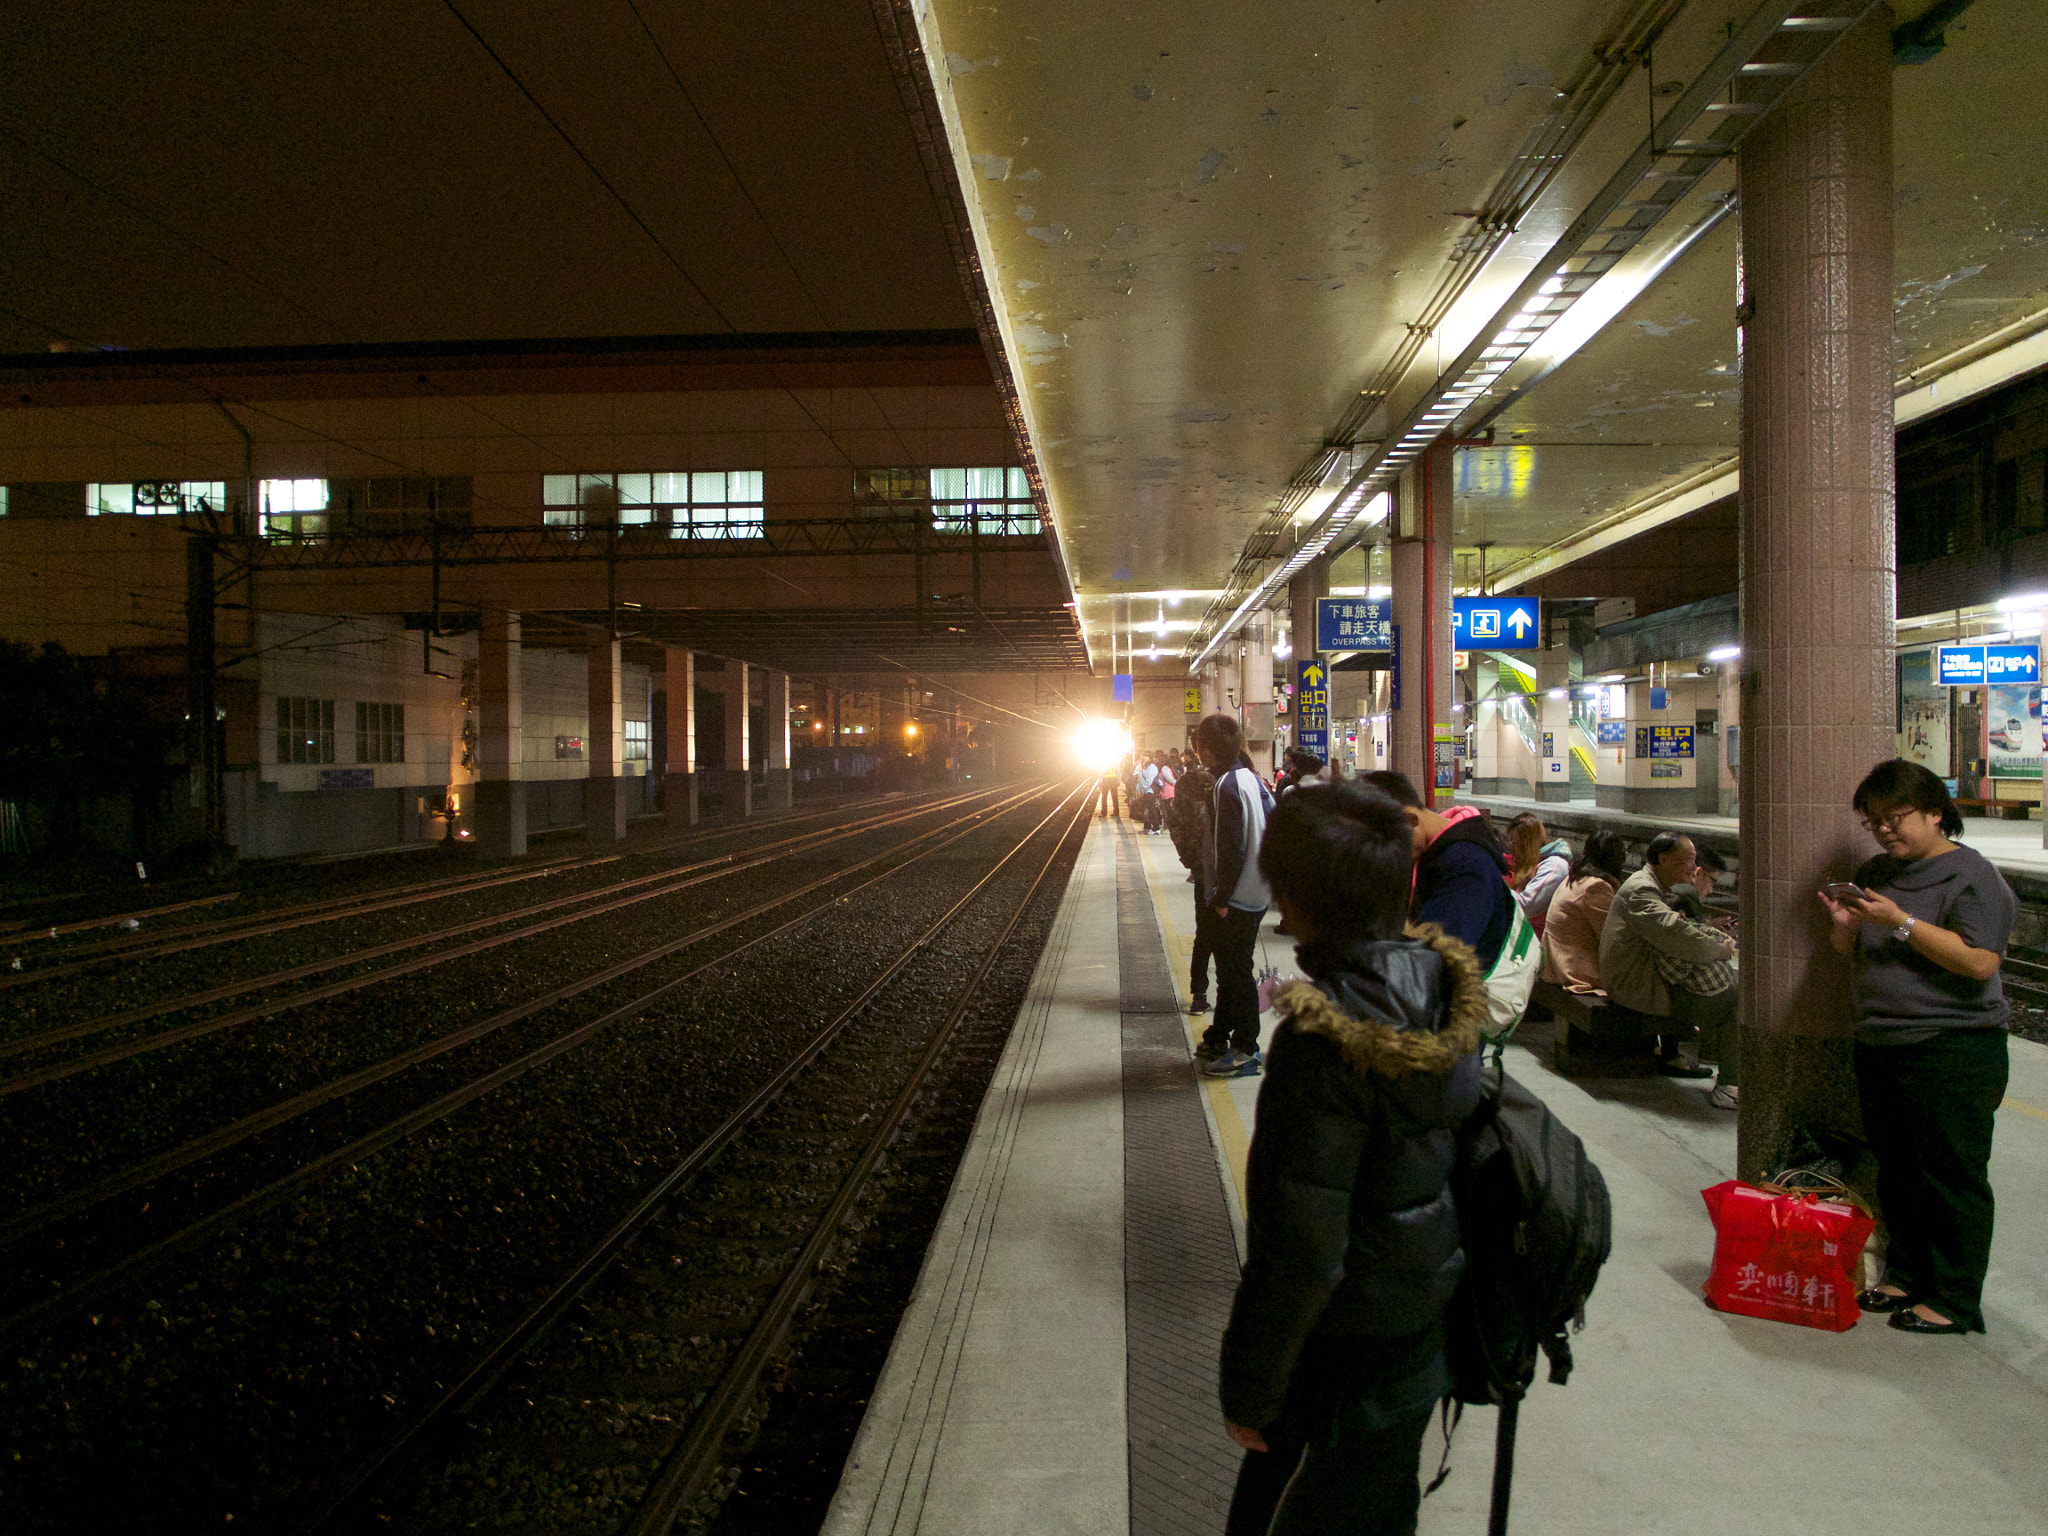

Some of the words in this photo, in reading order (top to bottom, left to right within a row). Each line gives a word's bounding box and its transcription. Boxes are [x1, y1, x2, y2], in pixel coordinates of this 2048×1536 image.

[1328, 604, 1380, 619] 下車旅客
[1339, 620, 1391, 635] 請走天橋
[1300, 690, 1326, 705] 出口
[1302, 705, 1324, 713] Exit
[1654, 727, 1691, 737] 出口
